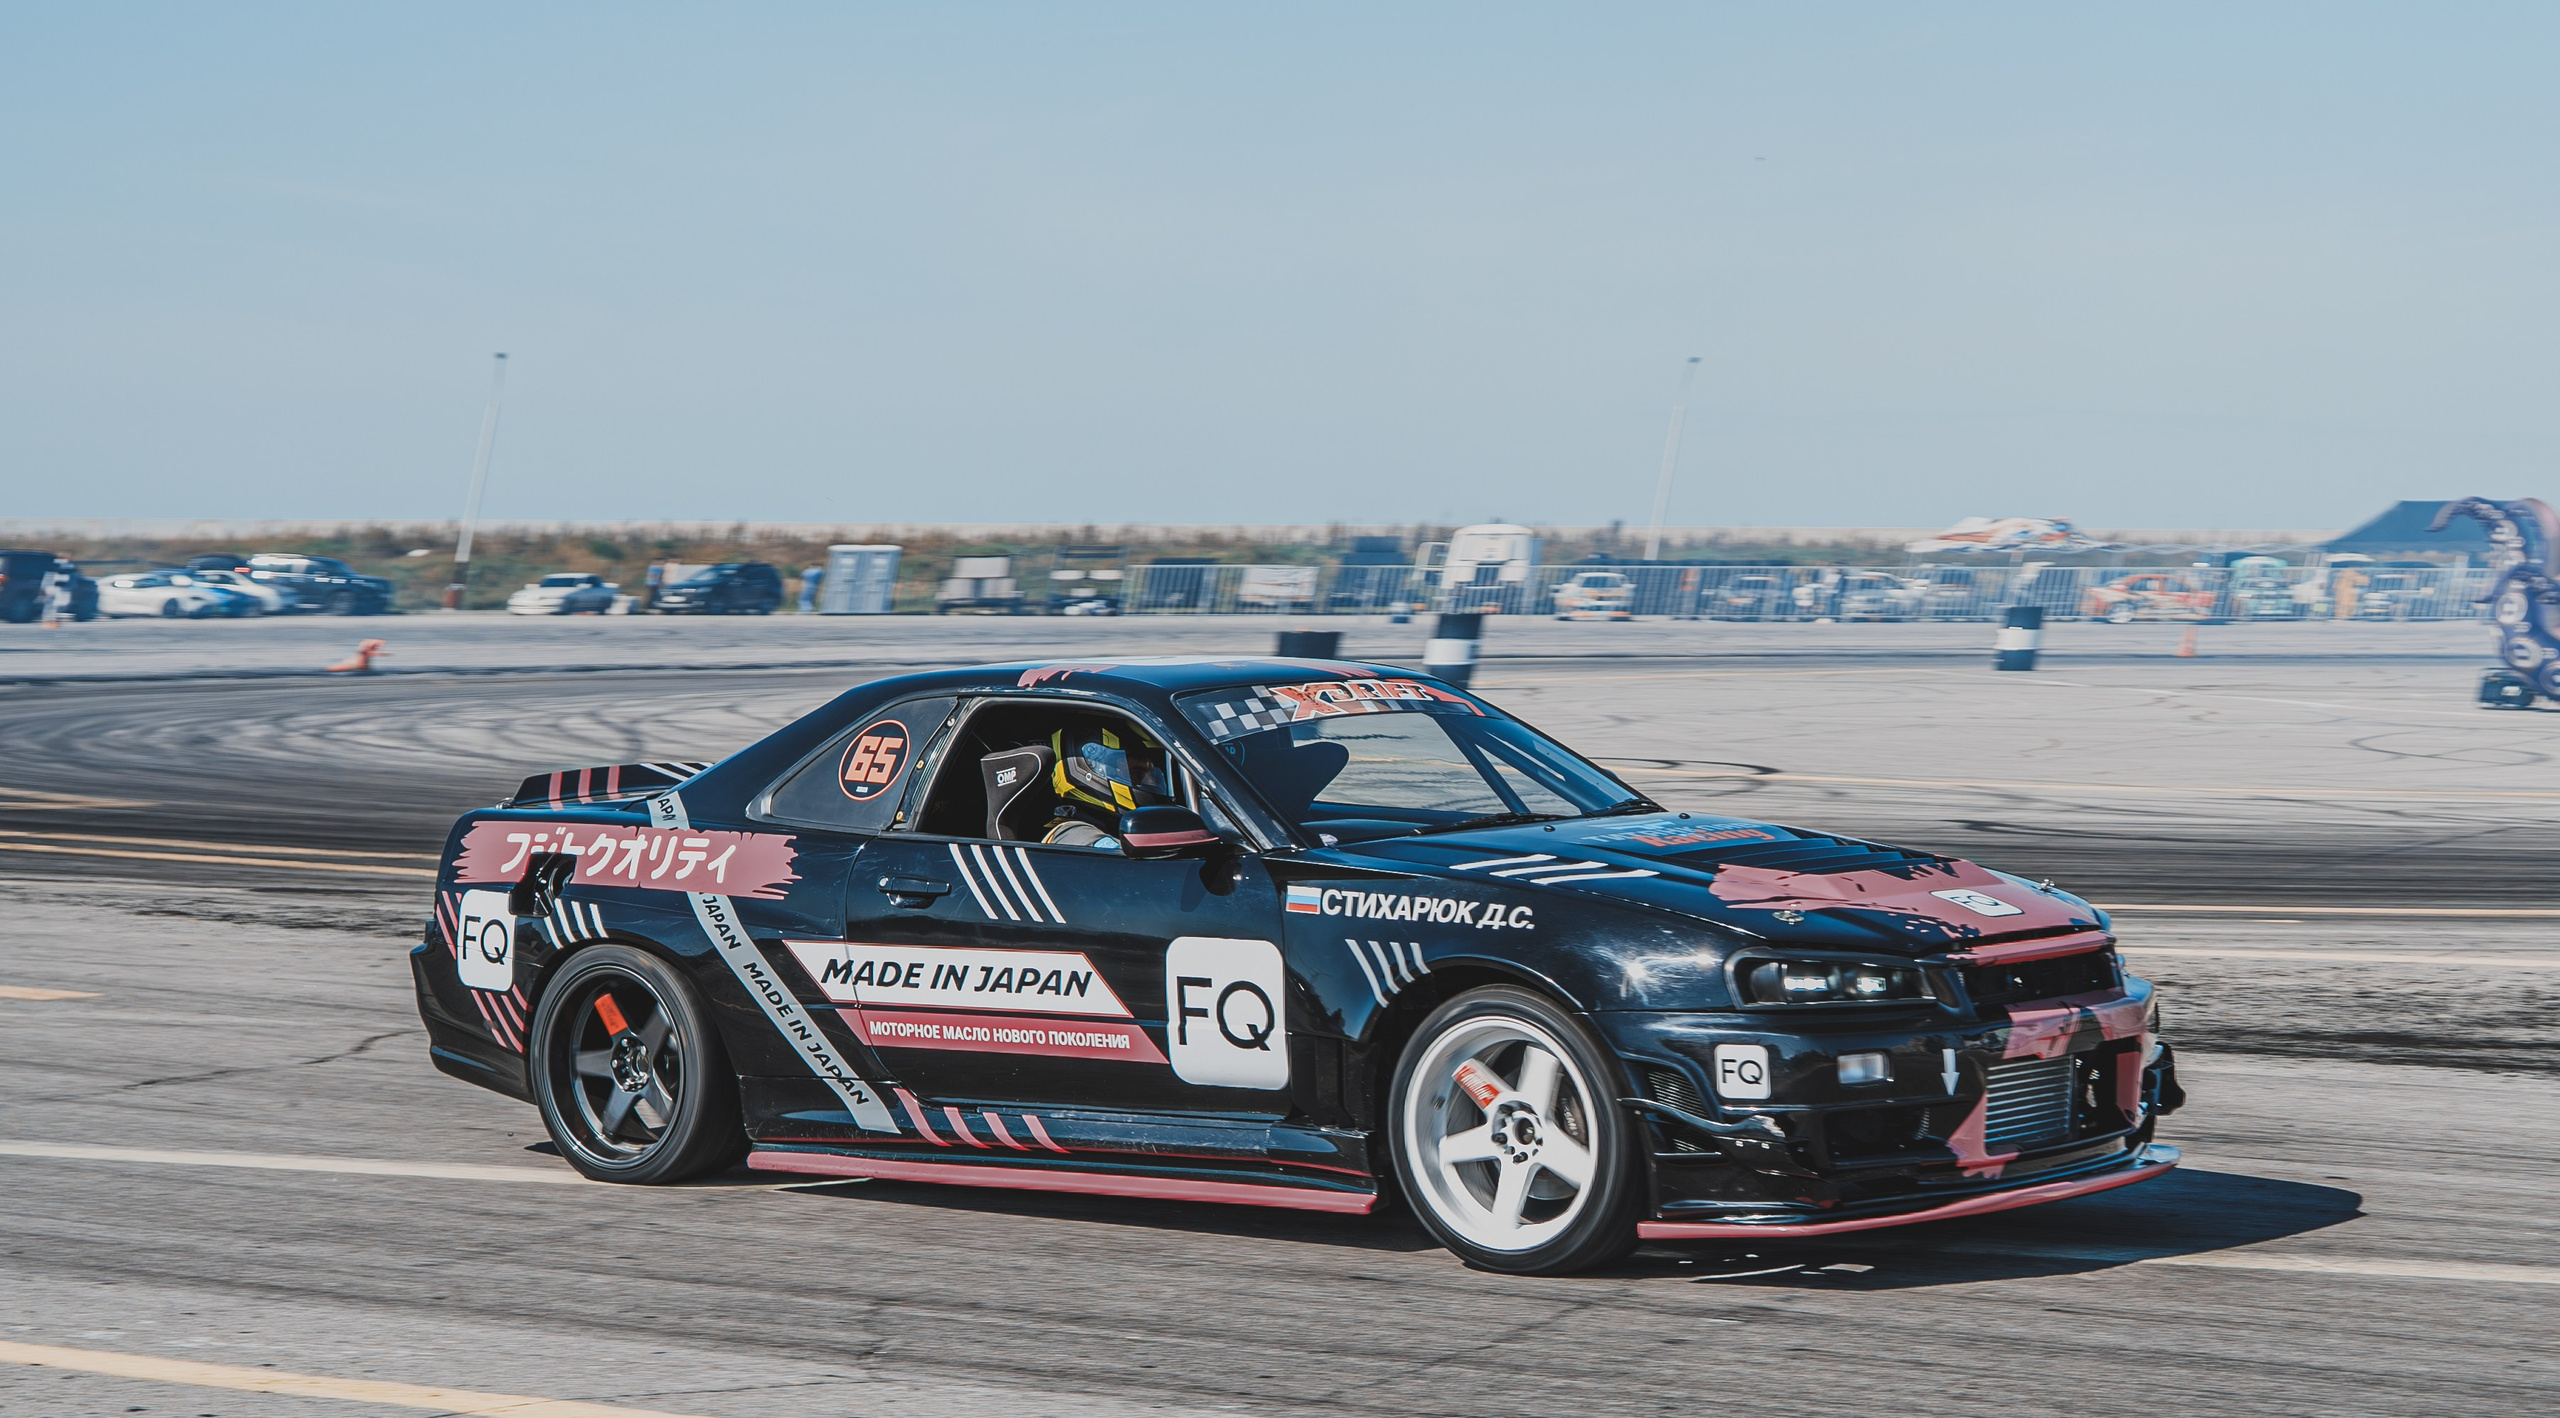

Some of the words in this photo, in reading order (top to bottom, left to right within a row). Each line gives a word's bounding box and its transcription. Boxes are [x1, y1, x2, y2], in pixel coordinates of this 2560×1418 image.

[844, 735, 904, 784] 65
[997, 769, 1017, 785] OMP
[1632, 829, 1776, 847] Racing
[1321, 889, 1481, 925] СТИХАРЮК
[1475, 903, 1536, 930] Д.С.
[1949, 895, 2000, 909] FQ
[462, 914, 509, 965] FQ
[820, 958, 925, 990] MADE
[929, 962, 971, 992] IN
[974, 966, 1094, 998] JAPAN
[702, 895, 742, 950] JAPAN
[742, 962, 794, 1019] MADE
[787, 1019, 813, 1041] IN
[806, 1042, 870, 1105] JAPAN
[1176, 976, 1275, 1052] FQ
[869, 1020, 941, 1040] МОТОРНОЕ
[942, 1025, 991, 1042] МАСЛО
[992, 1028, 1046, 1045] НОВОГО
[1048, 1030, 1131, 1050] ПОКОЛЕНИЯ
[1721, 1059, 1763, 1086] FQ
